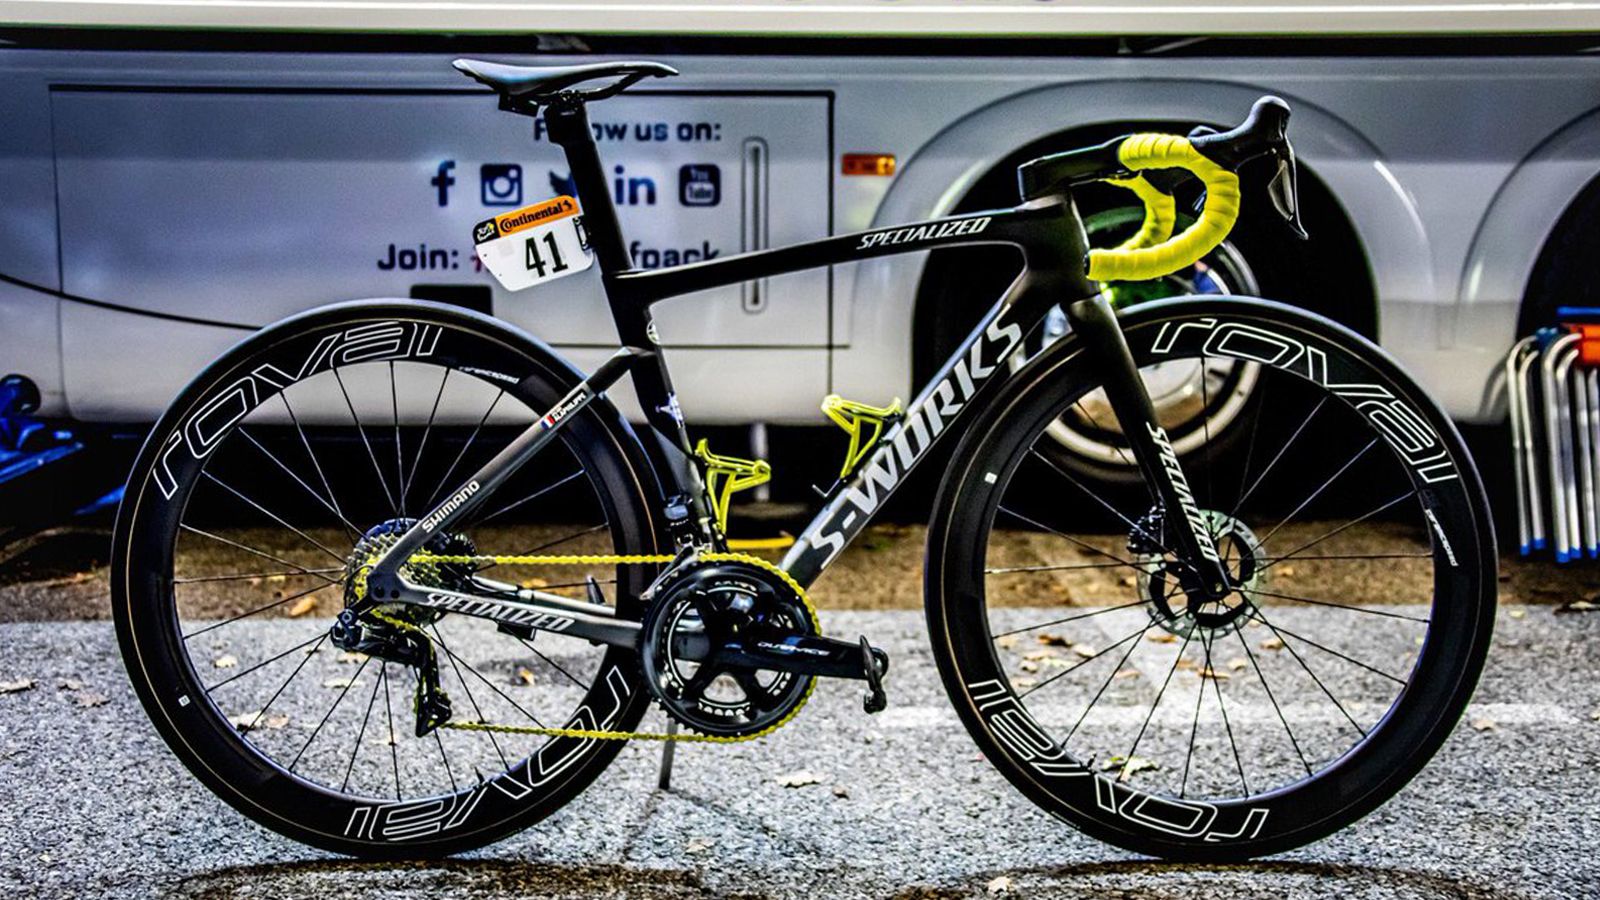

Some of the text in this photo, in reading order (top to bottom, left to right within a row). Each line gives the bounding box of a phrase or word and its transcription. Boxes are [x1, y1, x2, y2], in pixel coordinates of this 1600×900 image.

[534, 119, 721, 141] Fow us on:
[614, 164, 656, 205] in
[500, 202, 563, 233] Continental
[856, 215, 992, 252] SPECIALIZED
[377, 243, 459, 270] Join:
[526, 230, 568, 278] 41
[811, 302, 1022, 570] S-WORKS
[421, 480, 480, 534] SHIMANO
[1145, 421, 1220, 563] SPECIALIZED
[426, 591, 575, 632] SPECIALIZED
